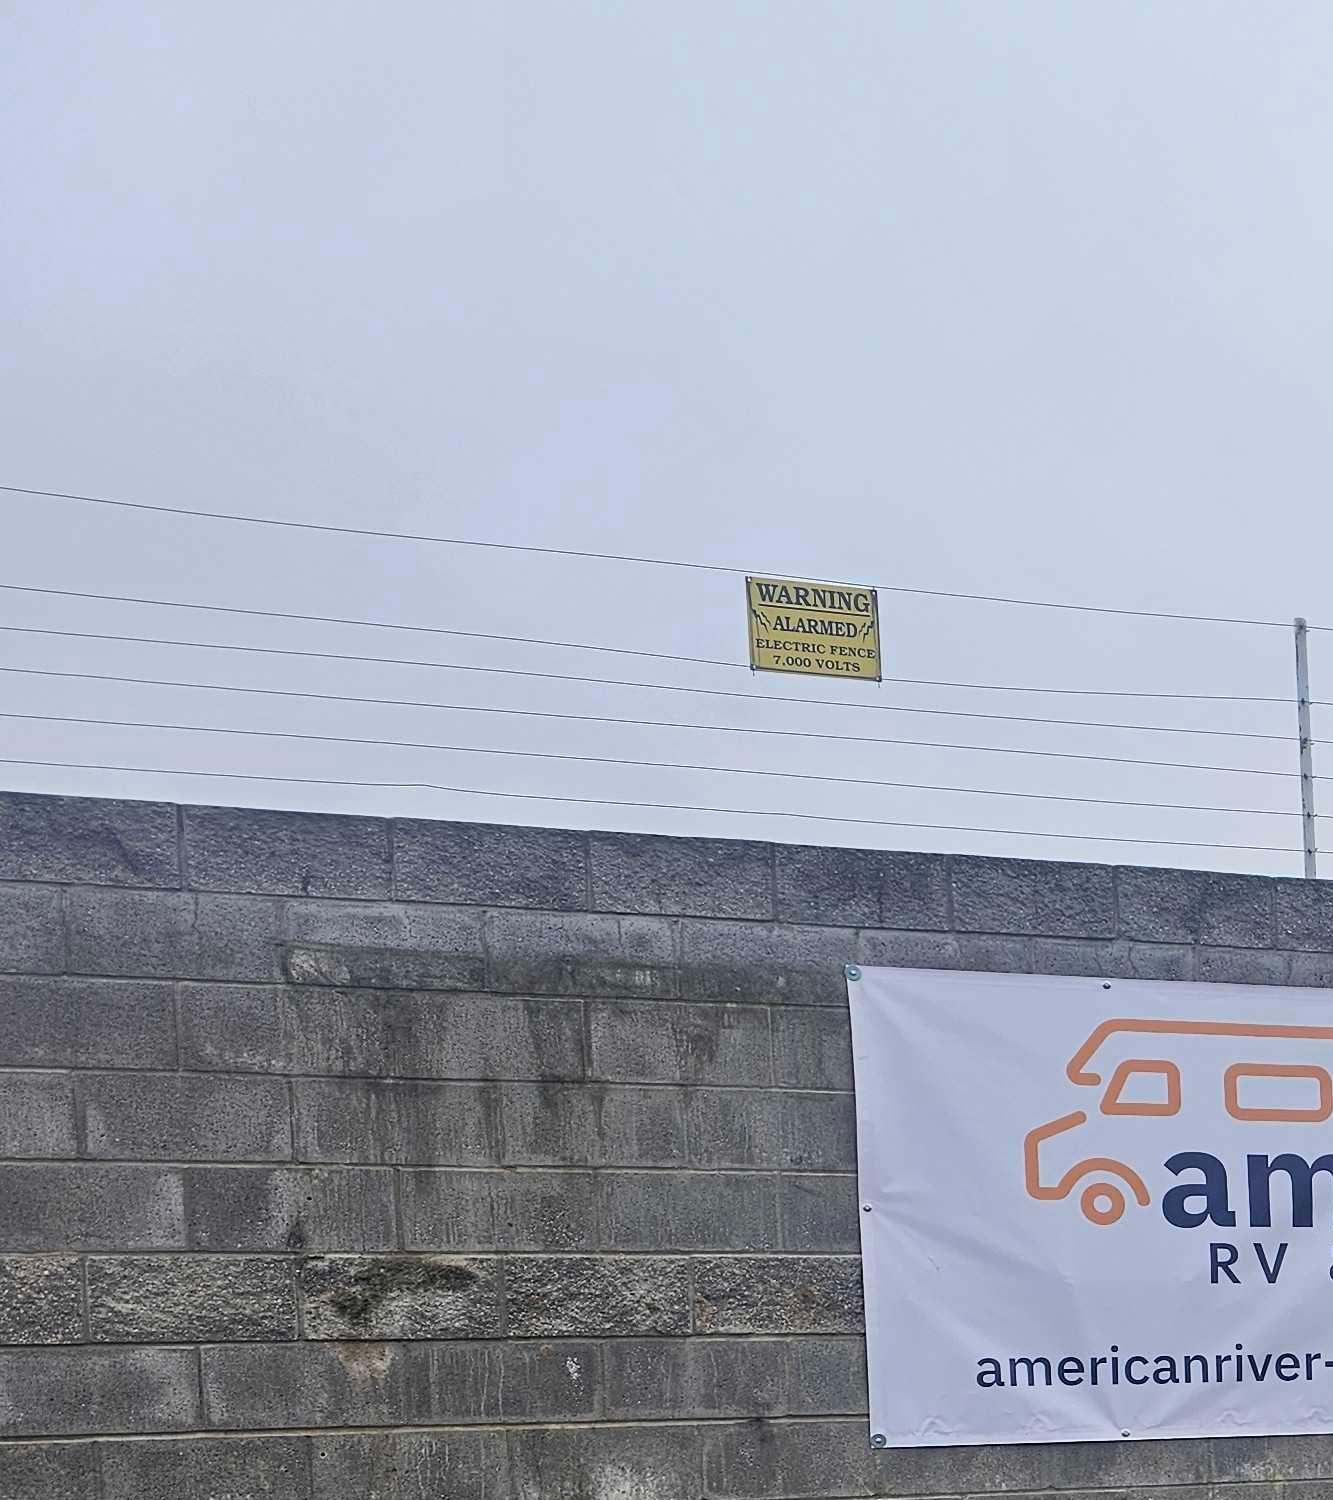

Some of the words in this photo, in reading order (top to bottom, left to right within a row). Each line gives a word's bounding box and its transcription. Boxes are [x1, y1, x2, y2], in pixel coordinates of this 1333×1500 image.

[756, 583, 870, 613] WARNING
[773, 616, 858, 638] ALARMED
[756, 638, 826, 654] ELECTRIC
[831, 645, 876, 659] FENCE
[815, 659, 861, 672] VOLTS
[1210, 1242, 1289, 1285] RV
